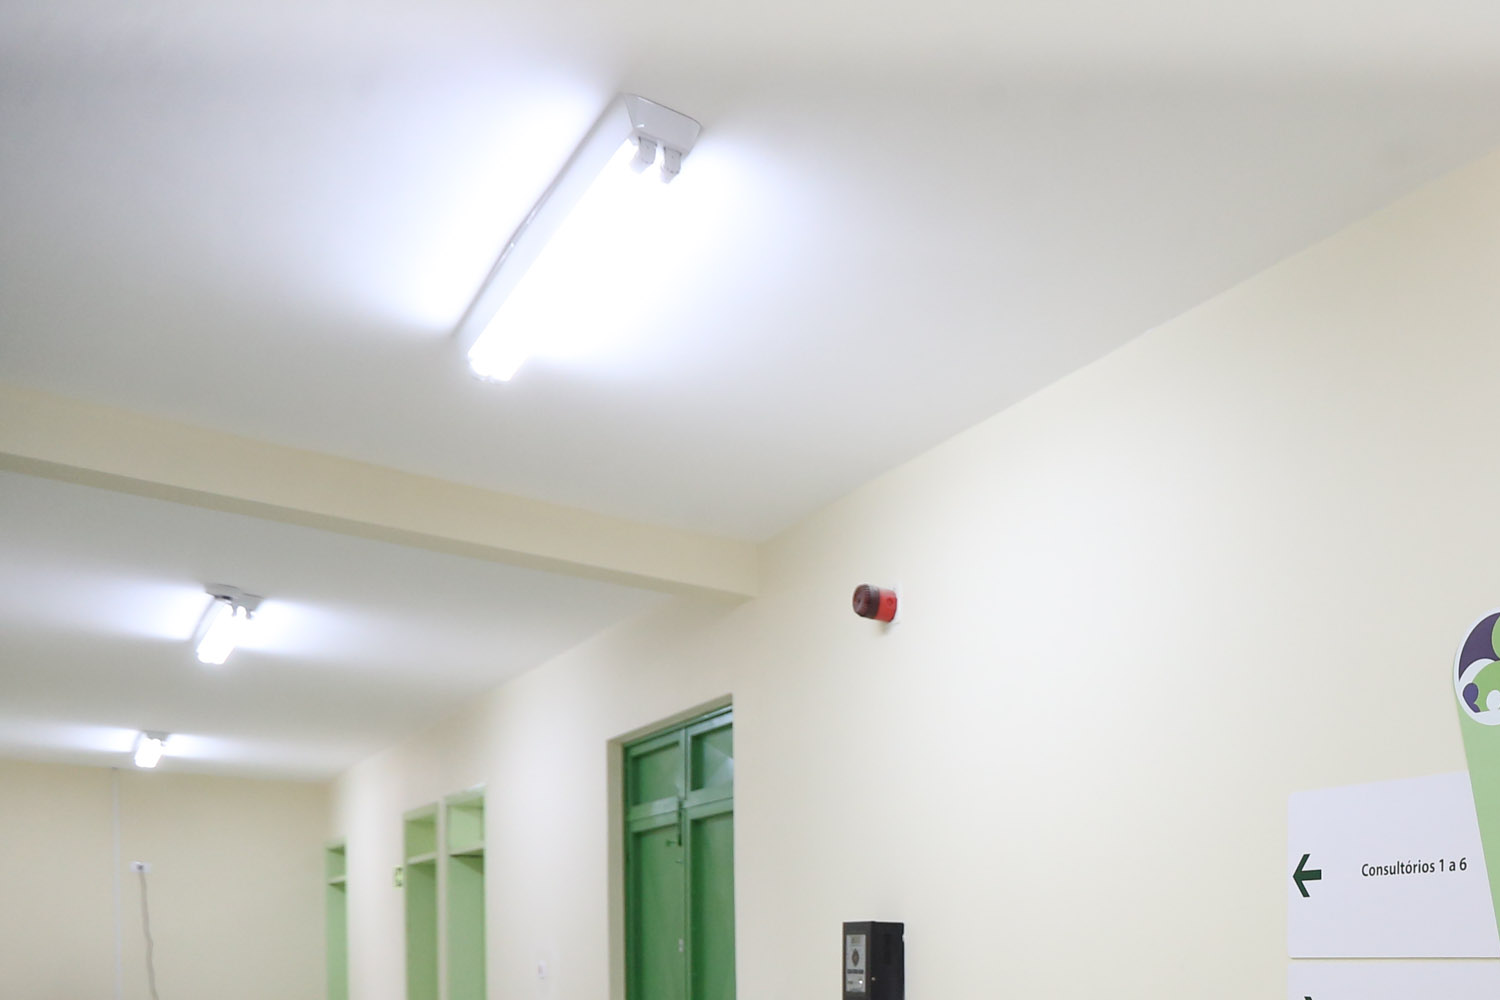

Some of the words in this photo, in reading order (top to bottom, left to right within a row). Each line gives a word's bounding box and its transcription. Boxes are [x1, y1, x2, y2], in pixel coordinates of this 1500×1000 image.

[1361, 860, 1436, 877] Consultórios
[1439, 858, 1444, 872] 1
[1448, 861, 1456, 872] a
[1459, 857, 1468, 872] 6
